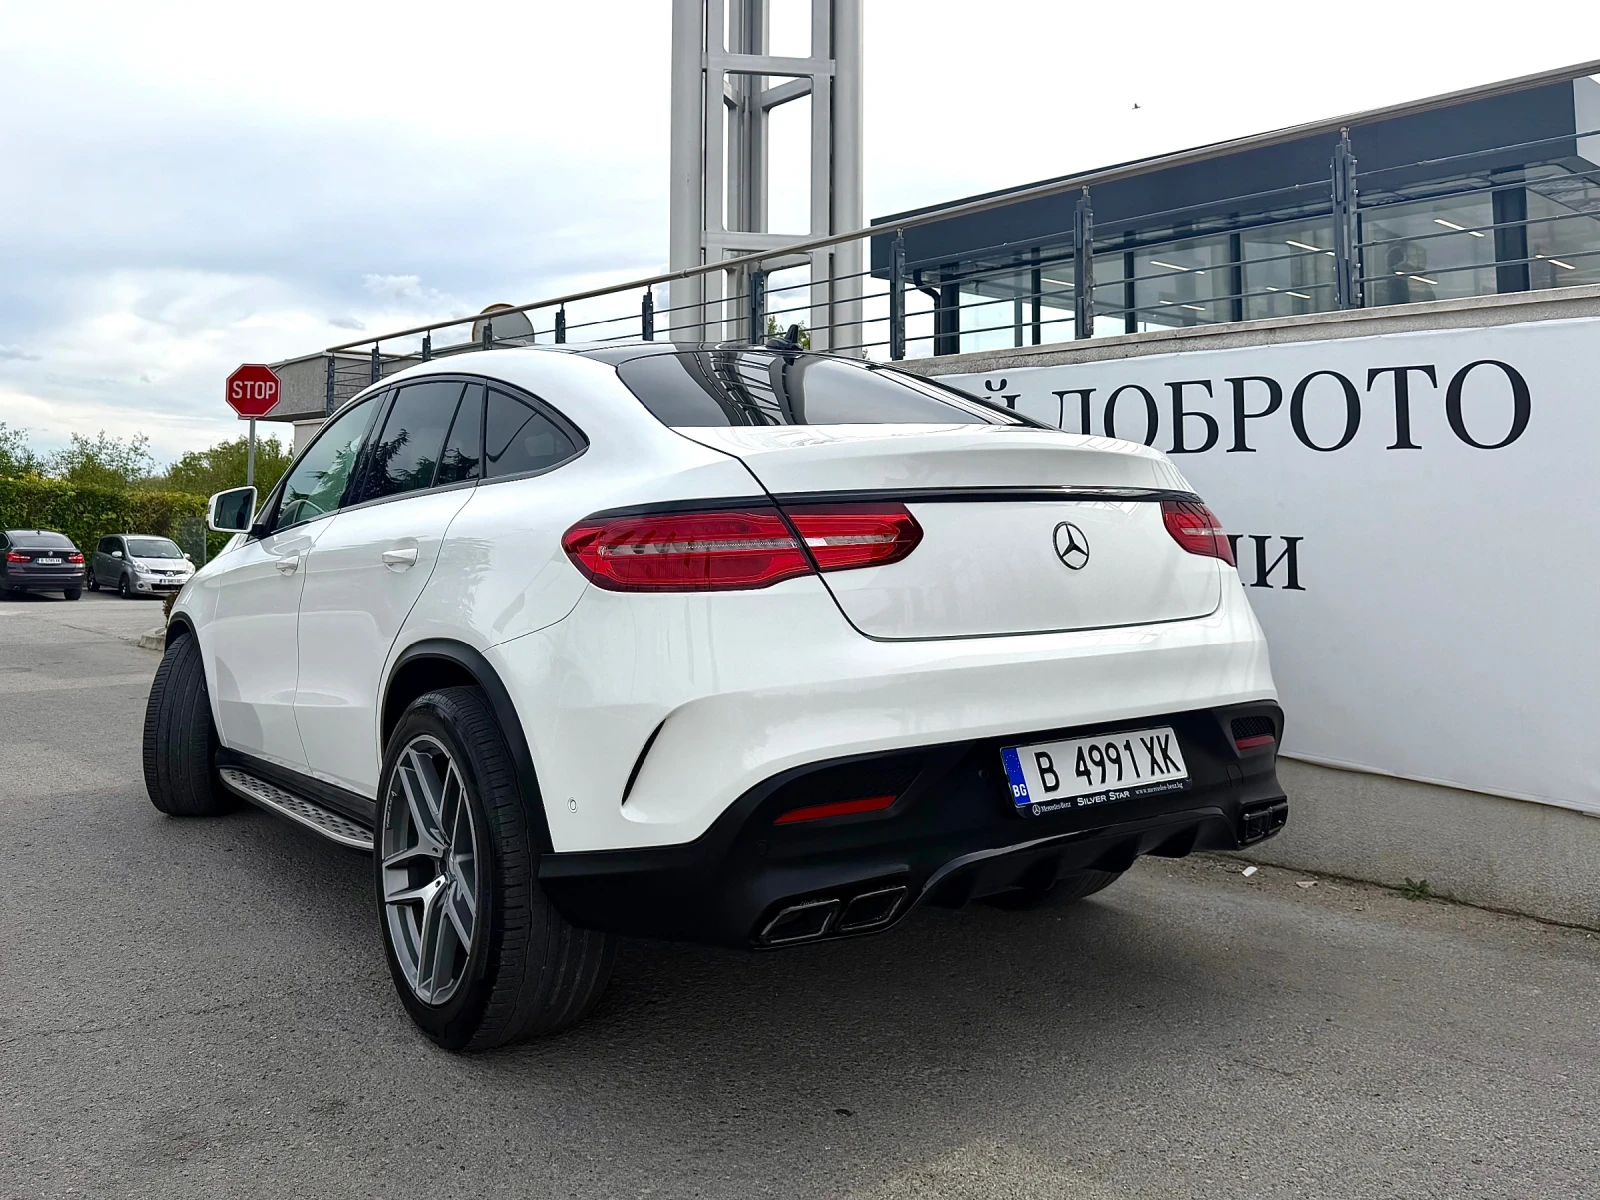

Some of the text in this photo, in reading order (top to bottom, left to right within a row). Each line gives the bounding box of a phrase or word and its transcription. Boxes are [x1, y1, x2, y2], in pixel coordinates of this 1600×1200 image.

[232, 380, 276, 399] STOP
[1033, 733, 1181, 793] B 4991 XK
[1012, 783, 1027, 798] BG
[1077, 794, 1107, 806] SILVER
[1108, 790, 1131, 801] STAR
